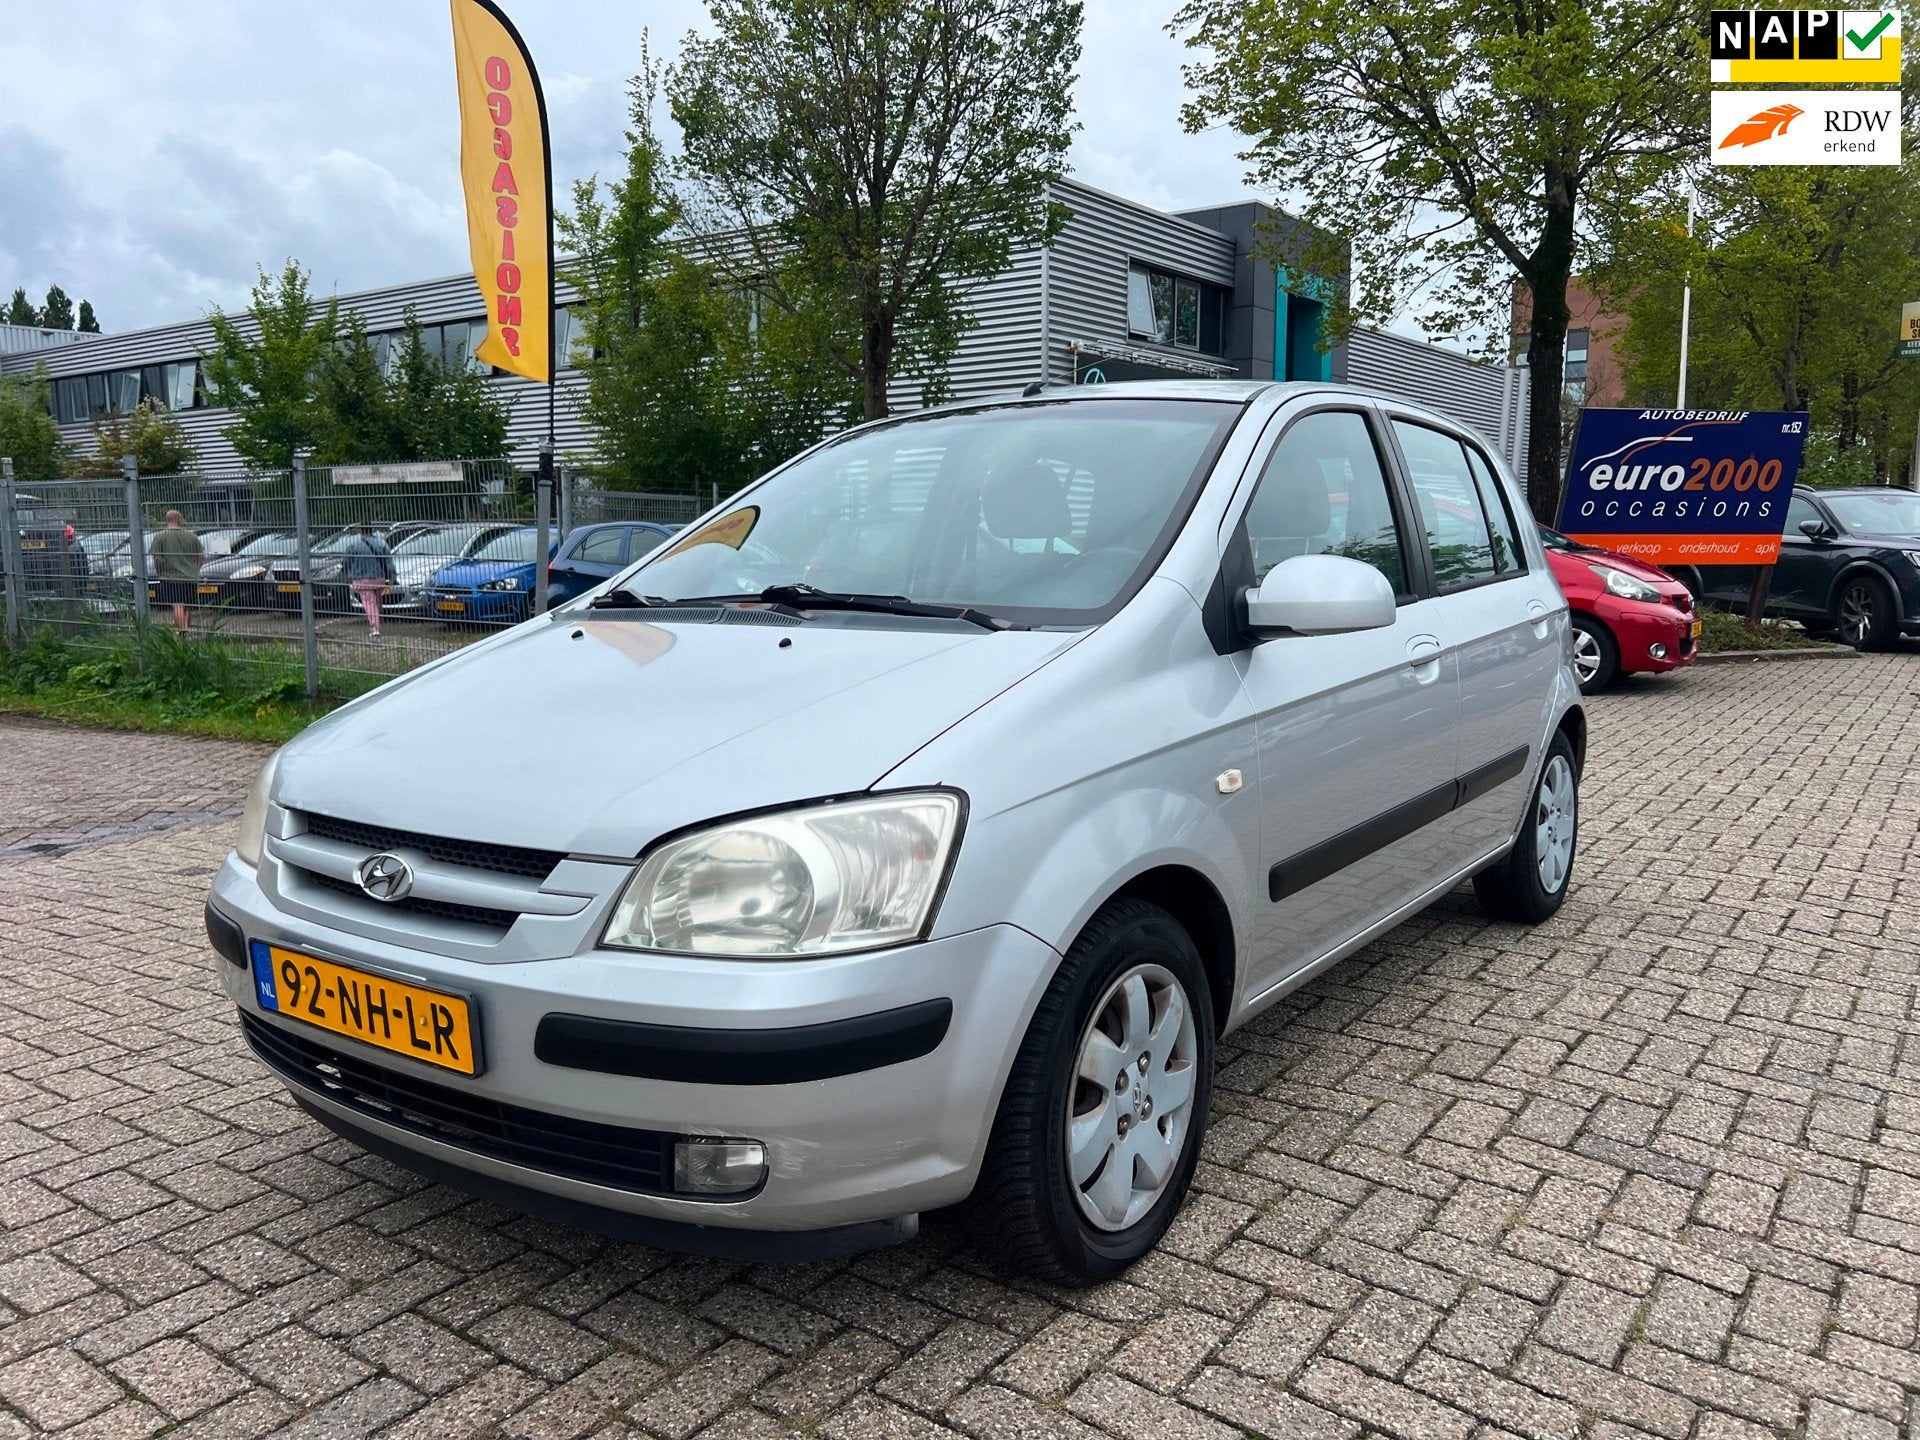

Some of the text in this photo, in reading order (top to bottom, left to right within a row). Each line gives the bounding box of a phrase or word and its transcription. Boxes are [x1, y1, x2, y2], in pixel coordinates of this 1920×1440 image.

[1639, 410, 1750, 421] AUTOBEDRIJF
[1588, 458, 1783, 492] euro2000
[1581, 497, 1772, 517] occasions
[1616, 542, 1776, 555] verkoop onderhoud apk
[261, 981, 275, 998] NL
[281, 959, 460, 1060] 92-NH-LR
